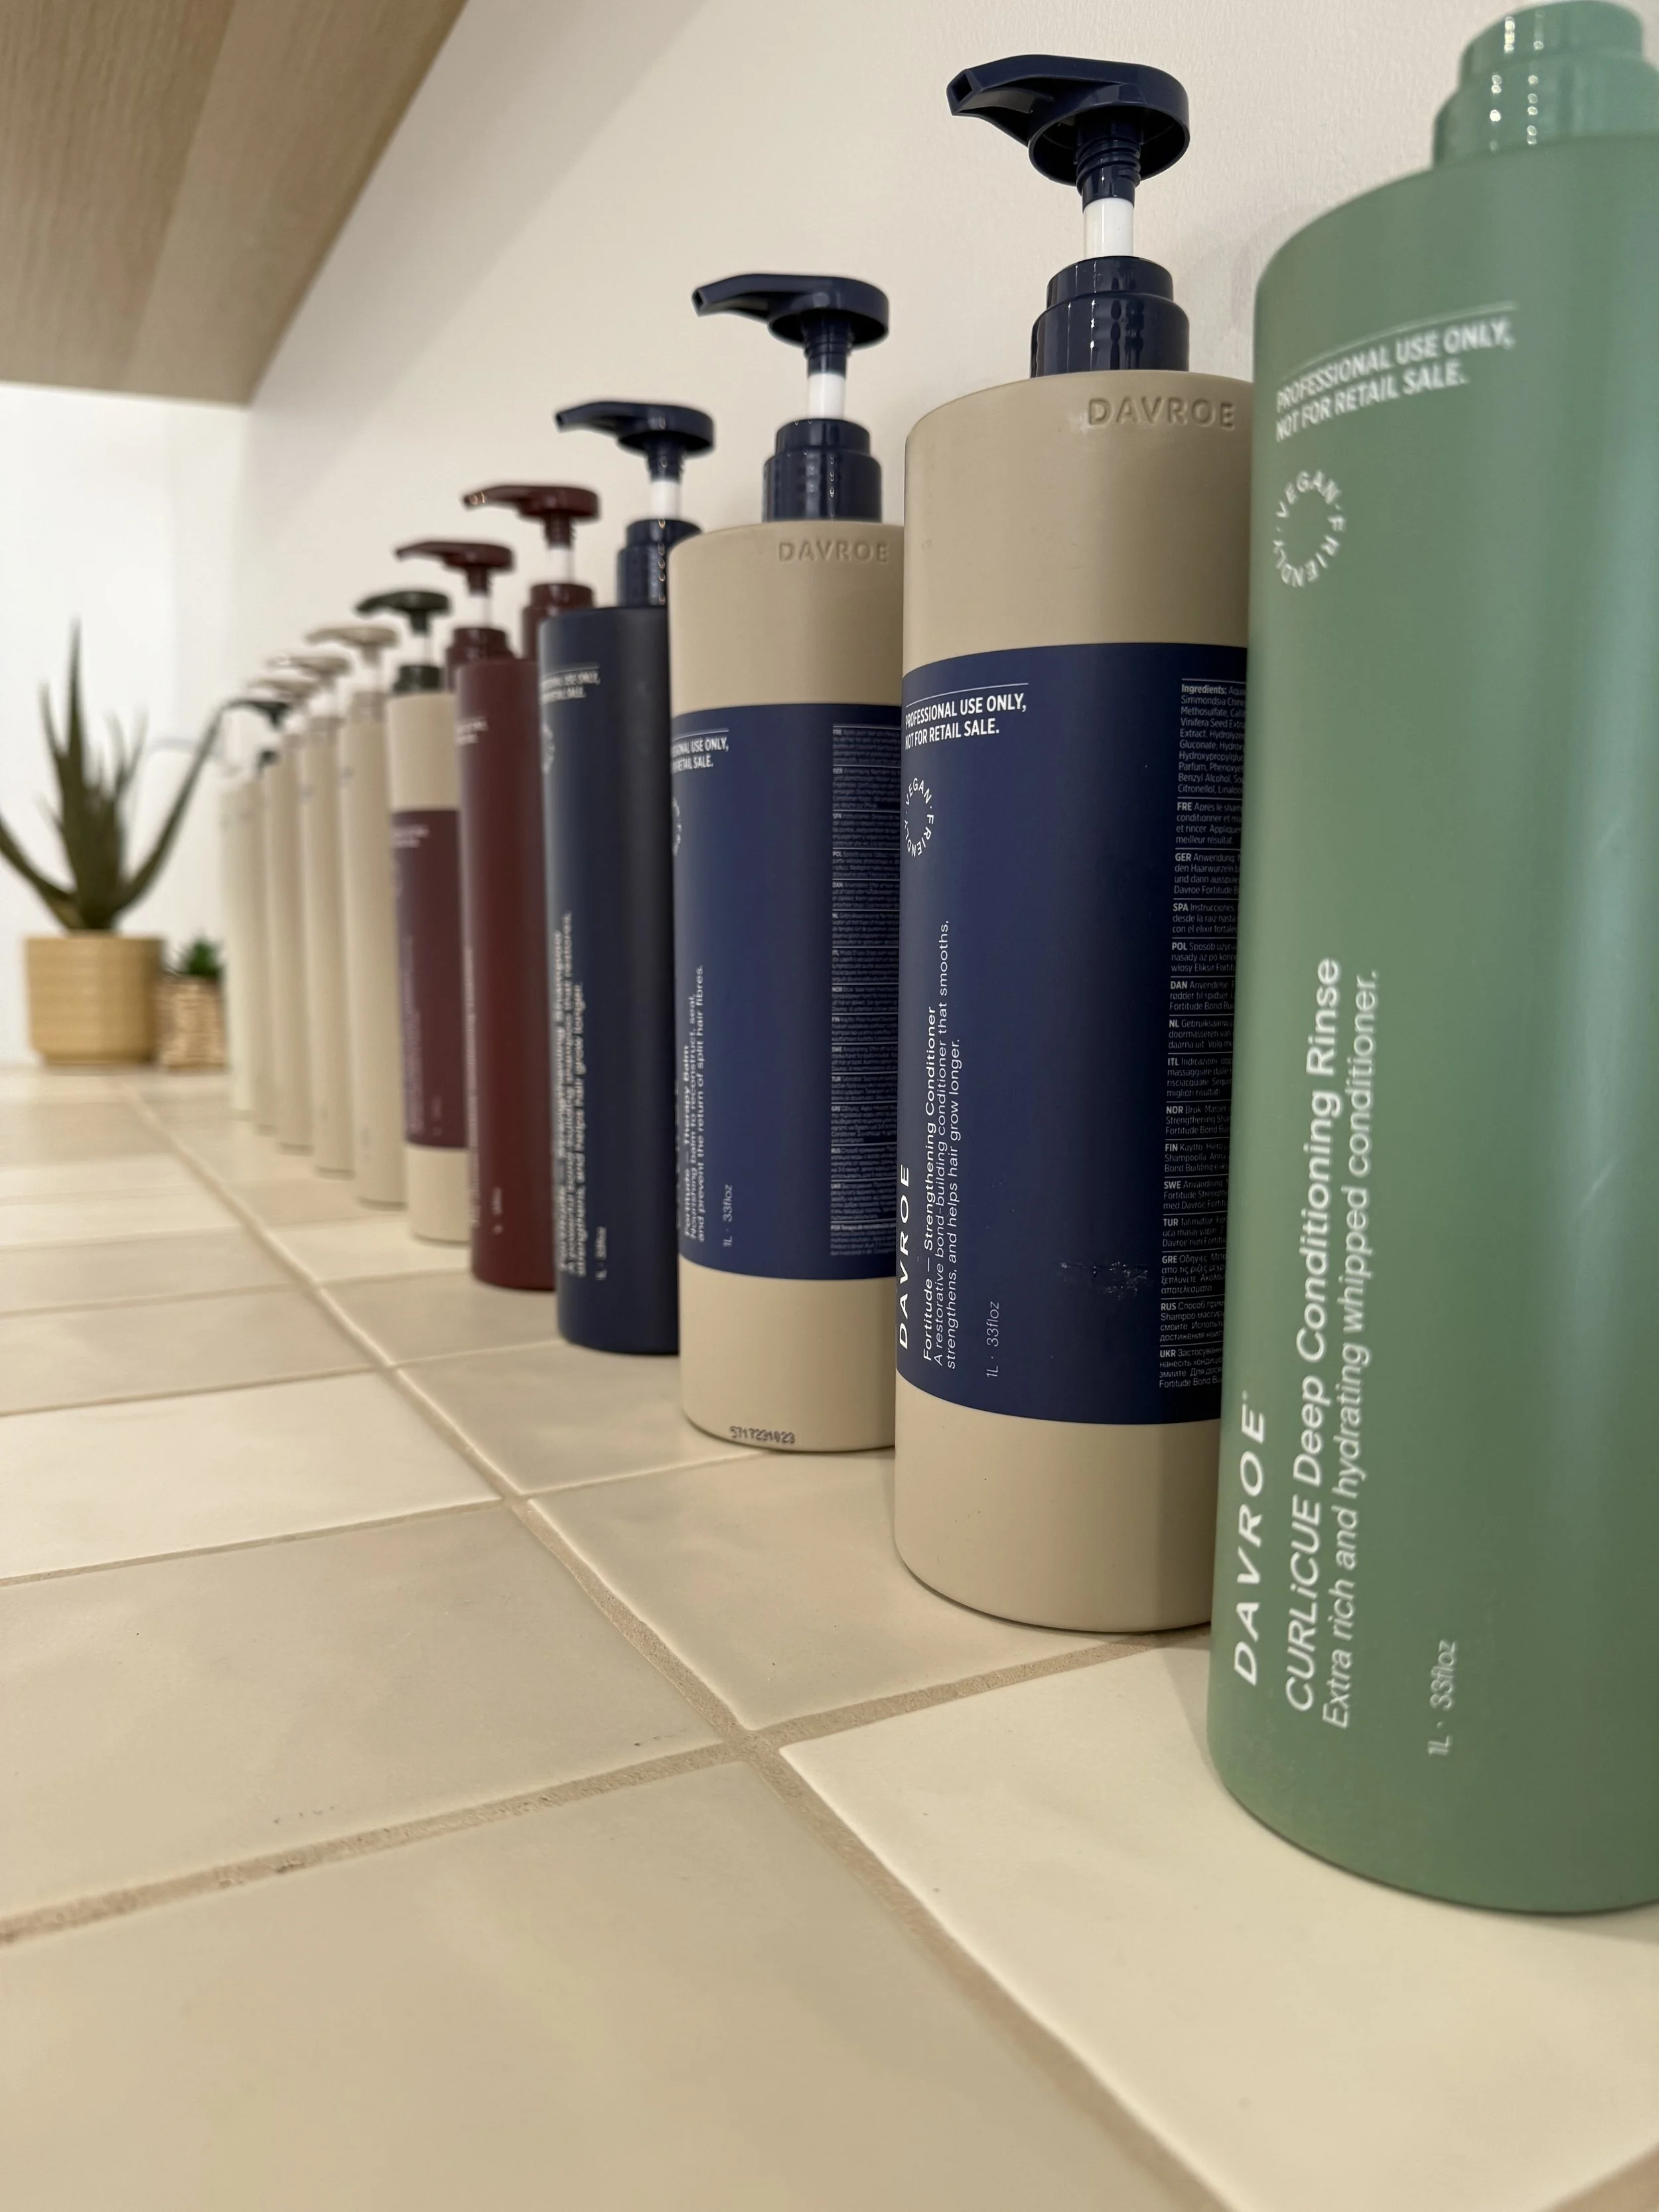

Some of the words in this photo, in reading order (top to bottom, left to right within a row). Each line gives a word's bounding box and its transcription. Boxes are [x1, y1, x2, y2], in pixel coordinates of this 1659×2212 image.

[1276, 345, 1391, 413] PROFESSIONAL
[1396, 331, 1439, 364] USE
[1443, 316, 1516, 354] ONLY,
[1088, 396, 1235, 431] DAVROE
[1276, 413, 1300, 442] NOT
[1301, 397, 1332, 429] FOR
[1334, 374, 1398, 416] RETAIL
[1402, 359, 1470, 396] SALE.
[1275, 469, 1342, 519] VEGAN
[779, 540, 889, 564] DAVROE
[1272, 514, 1346, 588] FRIENDLY
[1181, 684, 1226, 694] Ingredients:
[1181, 695, 1226, 705] Simmondsia
[905, 701, 957, 730] PROFESSIONAL
[960, 697, 983, 715] USE
[986, 693, 1027, 713] ONLY,
[1181, 717, 1209, 727] Vinifera
[1210, 718, 1228, 727] Seed
[690, 739, 703, 753] USE
[705, 737, 729, 752] ONLY,
[905, 731, 914, 751] NOT
[914, 727, 928, 747] FOR
[929, 722, 962, 742] RETAIL
[964, 718, 999, 737] SALE.
[693, 755, 713, 769] SALE.
[1178, 773, 1203, 783] Benzyl
[905, 777, 932, 806] VEGAN
[1177, 802, 1192, 811] FRE
[904, 813, 934, 857] FRIENDLY
[1176, 835, 1205, 844] meilleur
[1175, 853, 1191, 861] GER
[1175, 863, 1189, 873] den
[1174, 885, 1200, 894] Davroe
[1202, 885, 1232, 894] Fortitude
[1175, 874, 1189, 883] und
[1190, 875, 1209, 883] dann
[1173, 903, 1189, 911] SPA
[1173, 914, 1194, 922] desde
[1197, 914, 1203, 922] la
[938, 921, 950, 996] smooths,
[1171, 953, 1197, 962] nasady
[1171, 981, 1187, 990] DAN
[938, 1002, 947, 1035] that
[1170, 1001, 1202, 1010] Fortitude
[1204, 1001, 1222, 1010] Bond
[1306, 958, 1340, 1076] Rinse
[696, 1041, 705, 1069] split
[925, 1006, 936, 1116] Conditioner
[949, 1039, 962, 1095] longer.
[696, 1073, 703, 1087] of
[937, 1040, 946, 1136] conditioner
[1345, 969, 1378, 1178] conditioner.
[690, 1114, 696, 1127] to
[950, 1100, 961, 1141] grow
[1200, 1126, 1217, 1134] Bond
[948, 1145, 958, 1177] hair
[924, 1122, 936, 1251] Strengthening
[935, 1142, 947, 1257] bond-building
[1164, 1181, 1181, 1189] SWE
[723, 1184, 733, 1222] 33floz
[947, 1183, 960, 1227] helps
[723, 1236, 733, 1247] 1L
[1297, 1090, 1342, 1363] Conditioning
[899, 1164, 909, 1349] DAVROE
[947, 1232, 957, 1264] and
[1336, 1185, 1374, 1333] whipped
[923, 1278, 933, 1361] Fortitude
[934, 1263, 944, 1349] restorative
[946, 1269, 958, 1369] strengthens,
[1161, 1313, 1195, 1321] Shampoo
[986, 1301, 999, 1347] 33floz
[934, 1354, 942, 1366] A
[986, 1364, 999, 1378] 1L
[1293, 1375, 1331, 1487] Deep
[1331, 1343, 1371, 1499] hydrating
[1234, 1403, 1265, 1686] DAVROE
[1331, 1505, 1357, 1570] and
[1285, 1495, 1321, 1712] CURLiCUE
[1327, 1579, 1354, 1641] rich
[1322, 1648, 1352, 1729] Extra
[1429, 1639, 1456, 1710] 33floz
[1427, 1734, 1452, 1757] 1L
